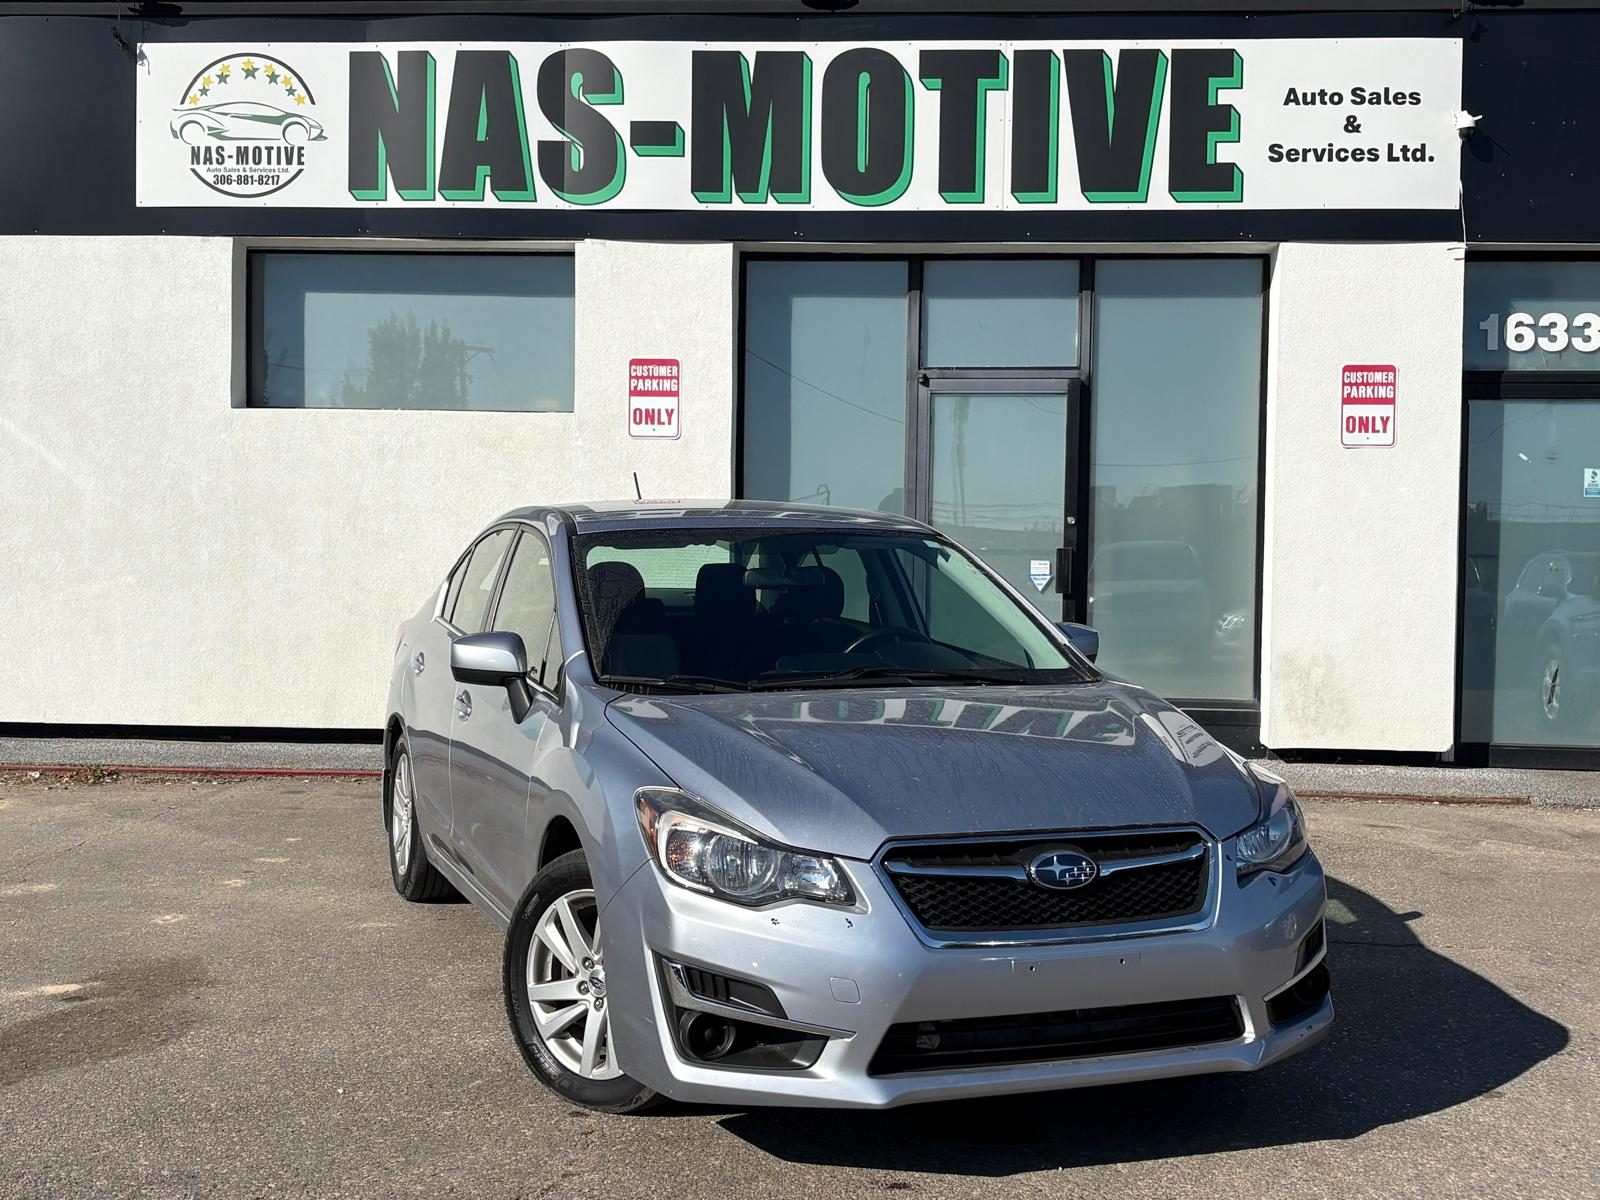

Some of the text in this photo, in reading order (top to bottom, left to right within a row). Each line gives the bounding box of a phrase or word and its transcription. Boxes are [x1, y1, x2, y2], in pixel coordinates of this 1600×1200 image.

[1283, 87, 1422, 106] Auto Sales
[348, 47, 1244, 207] NAS-MOTIVE
[1343, 115, 1362, 134] &
[190, 145, 305, 166] NAS-MOTIVE
[1268, 143, 1435, 163] Services Ltd.
[213, 174, 280, 186] 306-881-8217
[630, 365, 678, 377] CUSTOMER
[1343, 371, 1395, 384] CUSTOMER
[630, 378, 678, 392] PARKING
[1343, 385, 1395, 399] PARKING
[632, 407, 675, 426] ONLY
[1345, 415, 1391, 434] ONLY
